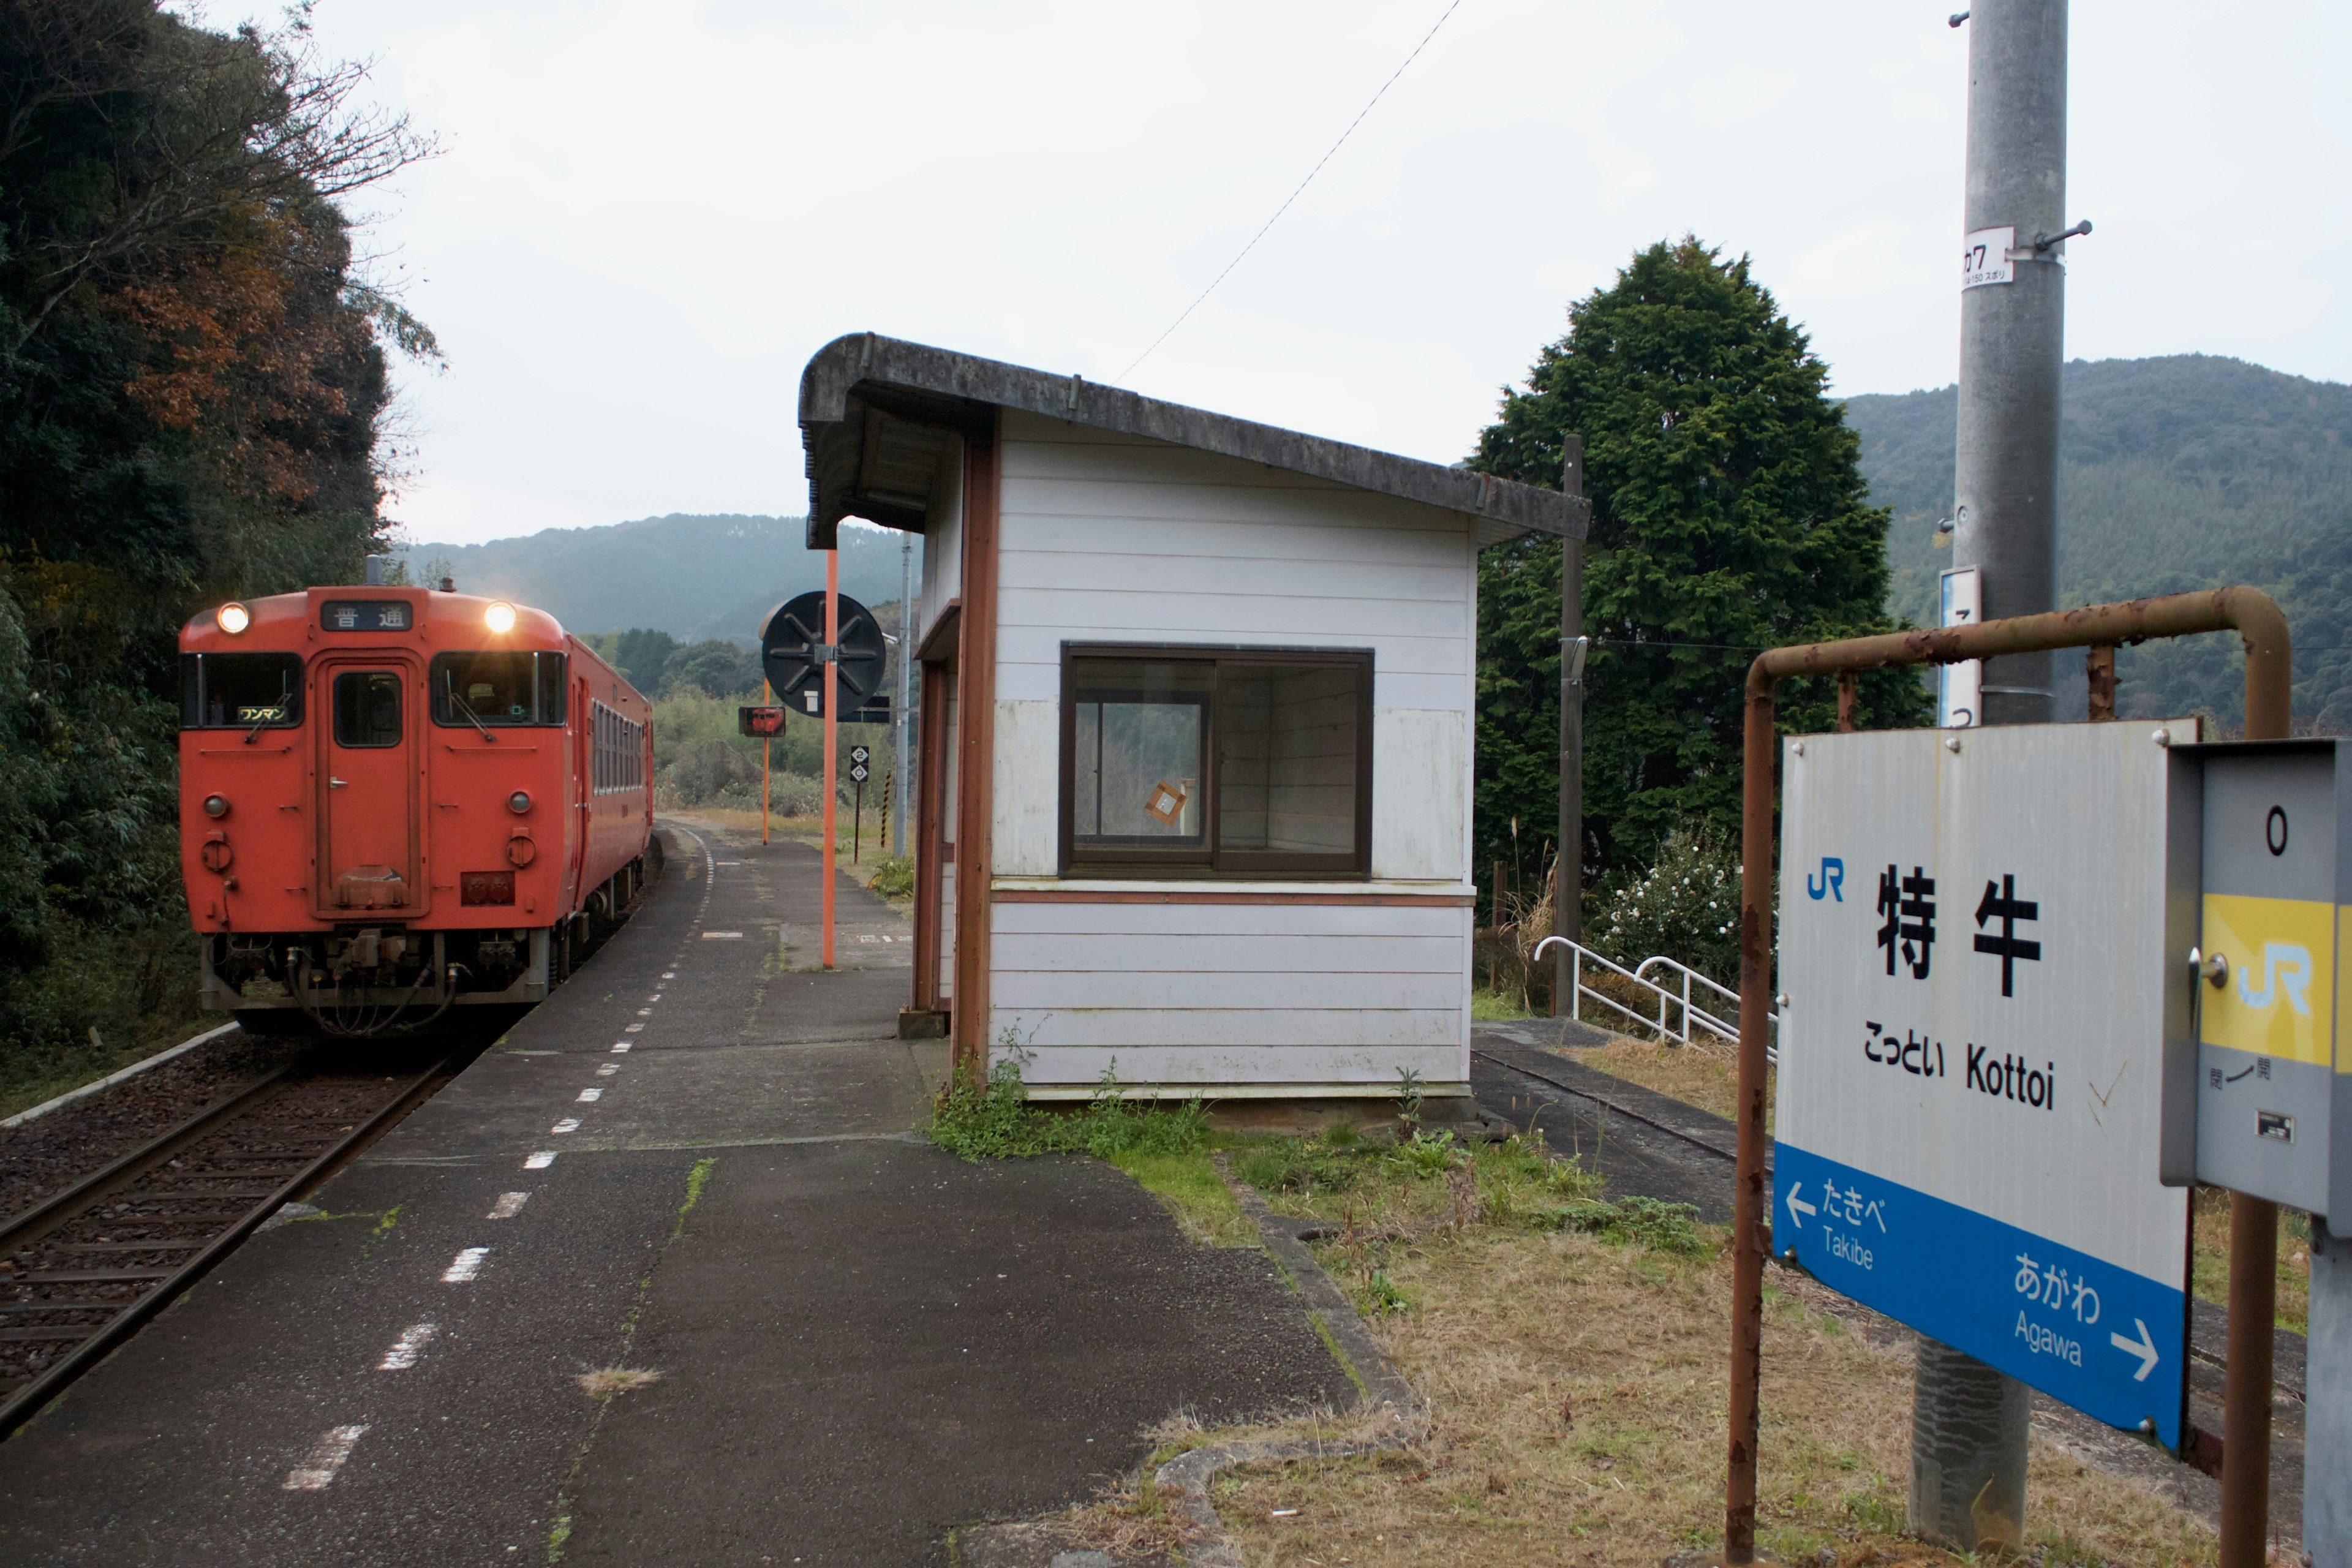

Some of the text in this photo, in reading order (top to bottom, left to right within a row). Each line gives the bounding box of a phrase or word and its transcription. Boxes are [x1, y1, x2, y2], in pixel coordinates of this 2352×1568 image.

[334, 606, 404, 628] 普通
[240, 708, 285, 720] ワンマン
[1807, 857, 1844, 902] JR
[1877, 864, 2041, 998] 特牛
[2238, 942, 2312, 1016] JR
[1865, 1020, 2054, 1110] こっとい Kottoi
[2257, 1057, 2271, 1080] 開
[1823, 1178, 1887, 1234] たきべ
[1823, 1224, 1874, 1270] Takibe
[2015, 1252, 2101, 1325] あがわ
[2015, 1309, 2082, 1368] Agawa
